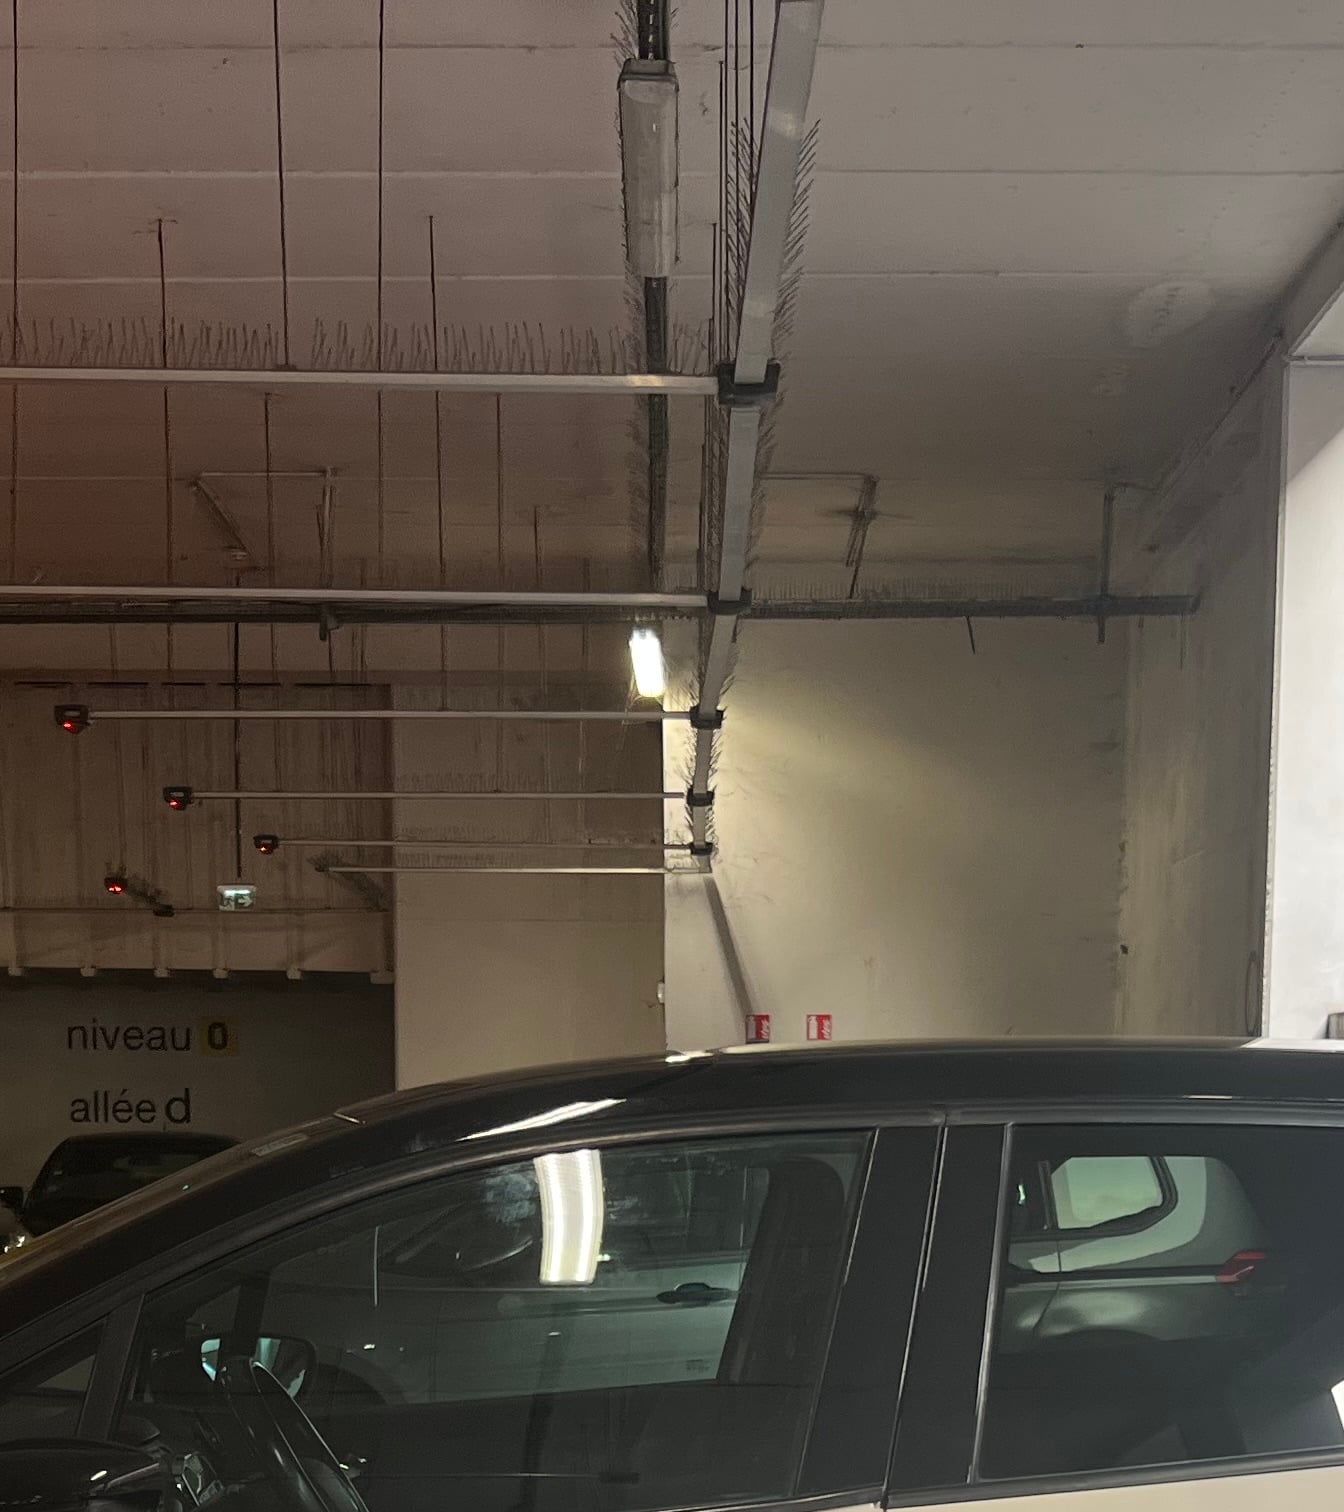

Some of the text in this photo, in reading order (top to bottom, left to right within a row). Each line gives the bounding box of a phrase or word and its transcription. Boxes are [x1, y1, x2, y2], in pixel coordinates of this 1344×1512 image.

[67, 1018, 229, 1051] niveau 0
[70, 1087, 191, 1124] allée d
